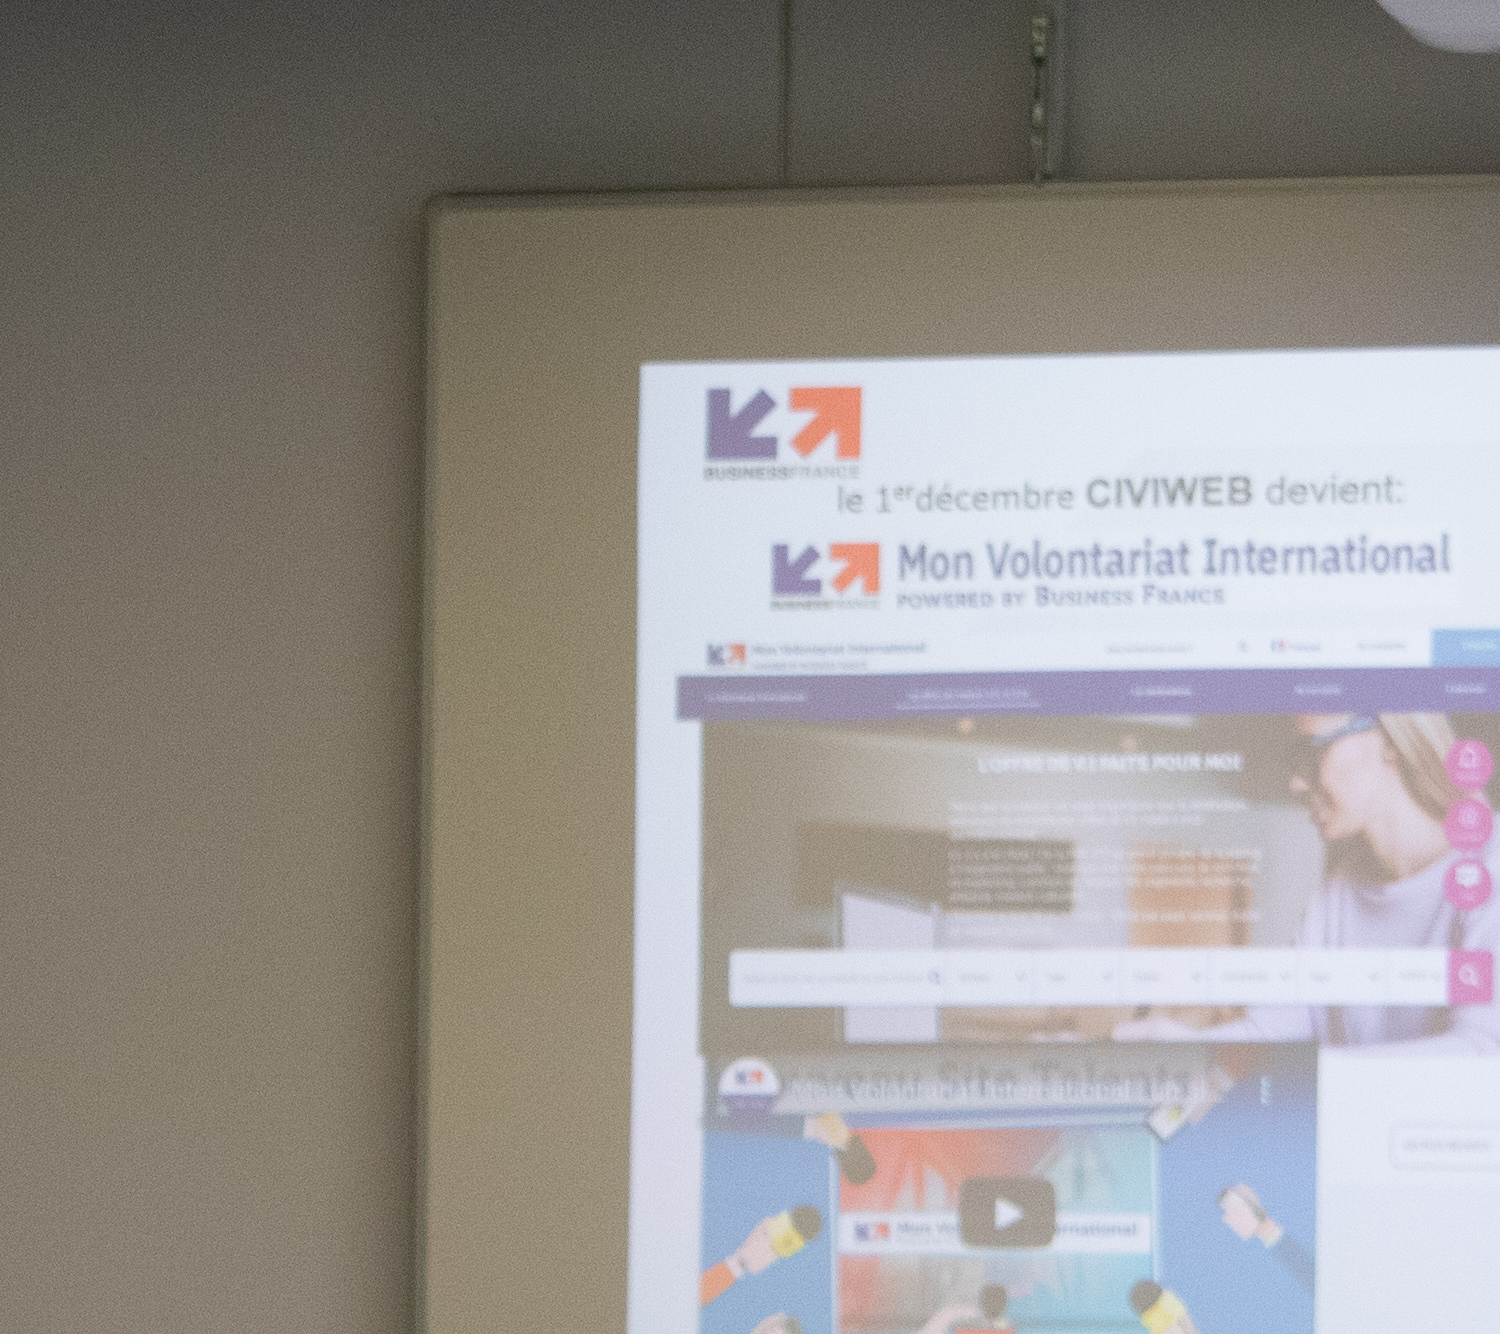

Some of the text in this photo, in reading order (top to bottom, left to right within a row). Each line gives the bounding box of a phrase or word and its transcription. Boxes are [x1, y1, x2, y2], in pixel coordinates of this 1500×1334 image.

[836, 484, 864, 514] le
[1085, 475, 1253, 509] CIVIWEB
[1264, 474, 1405, 507] devient:
[897, 532, 1452, 582] Mon Volontariat International
